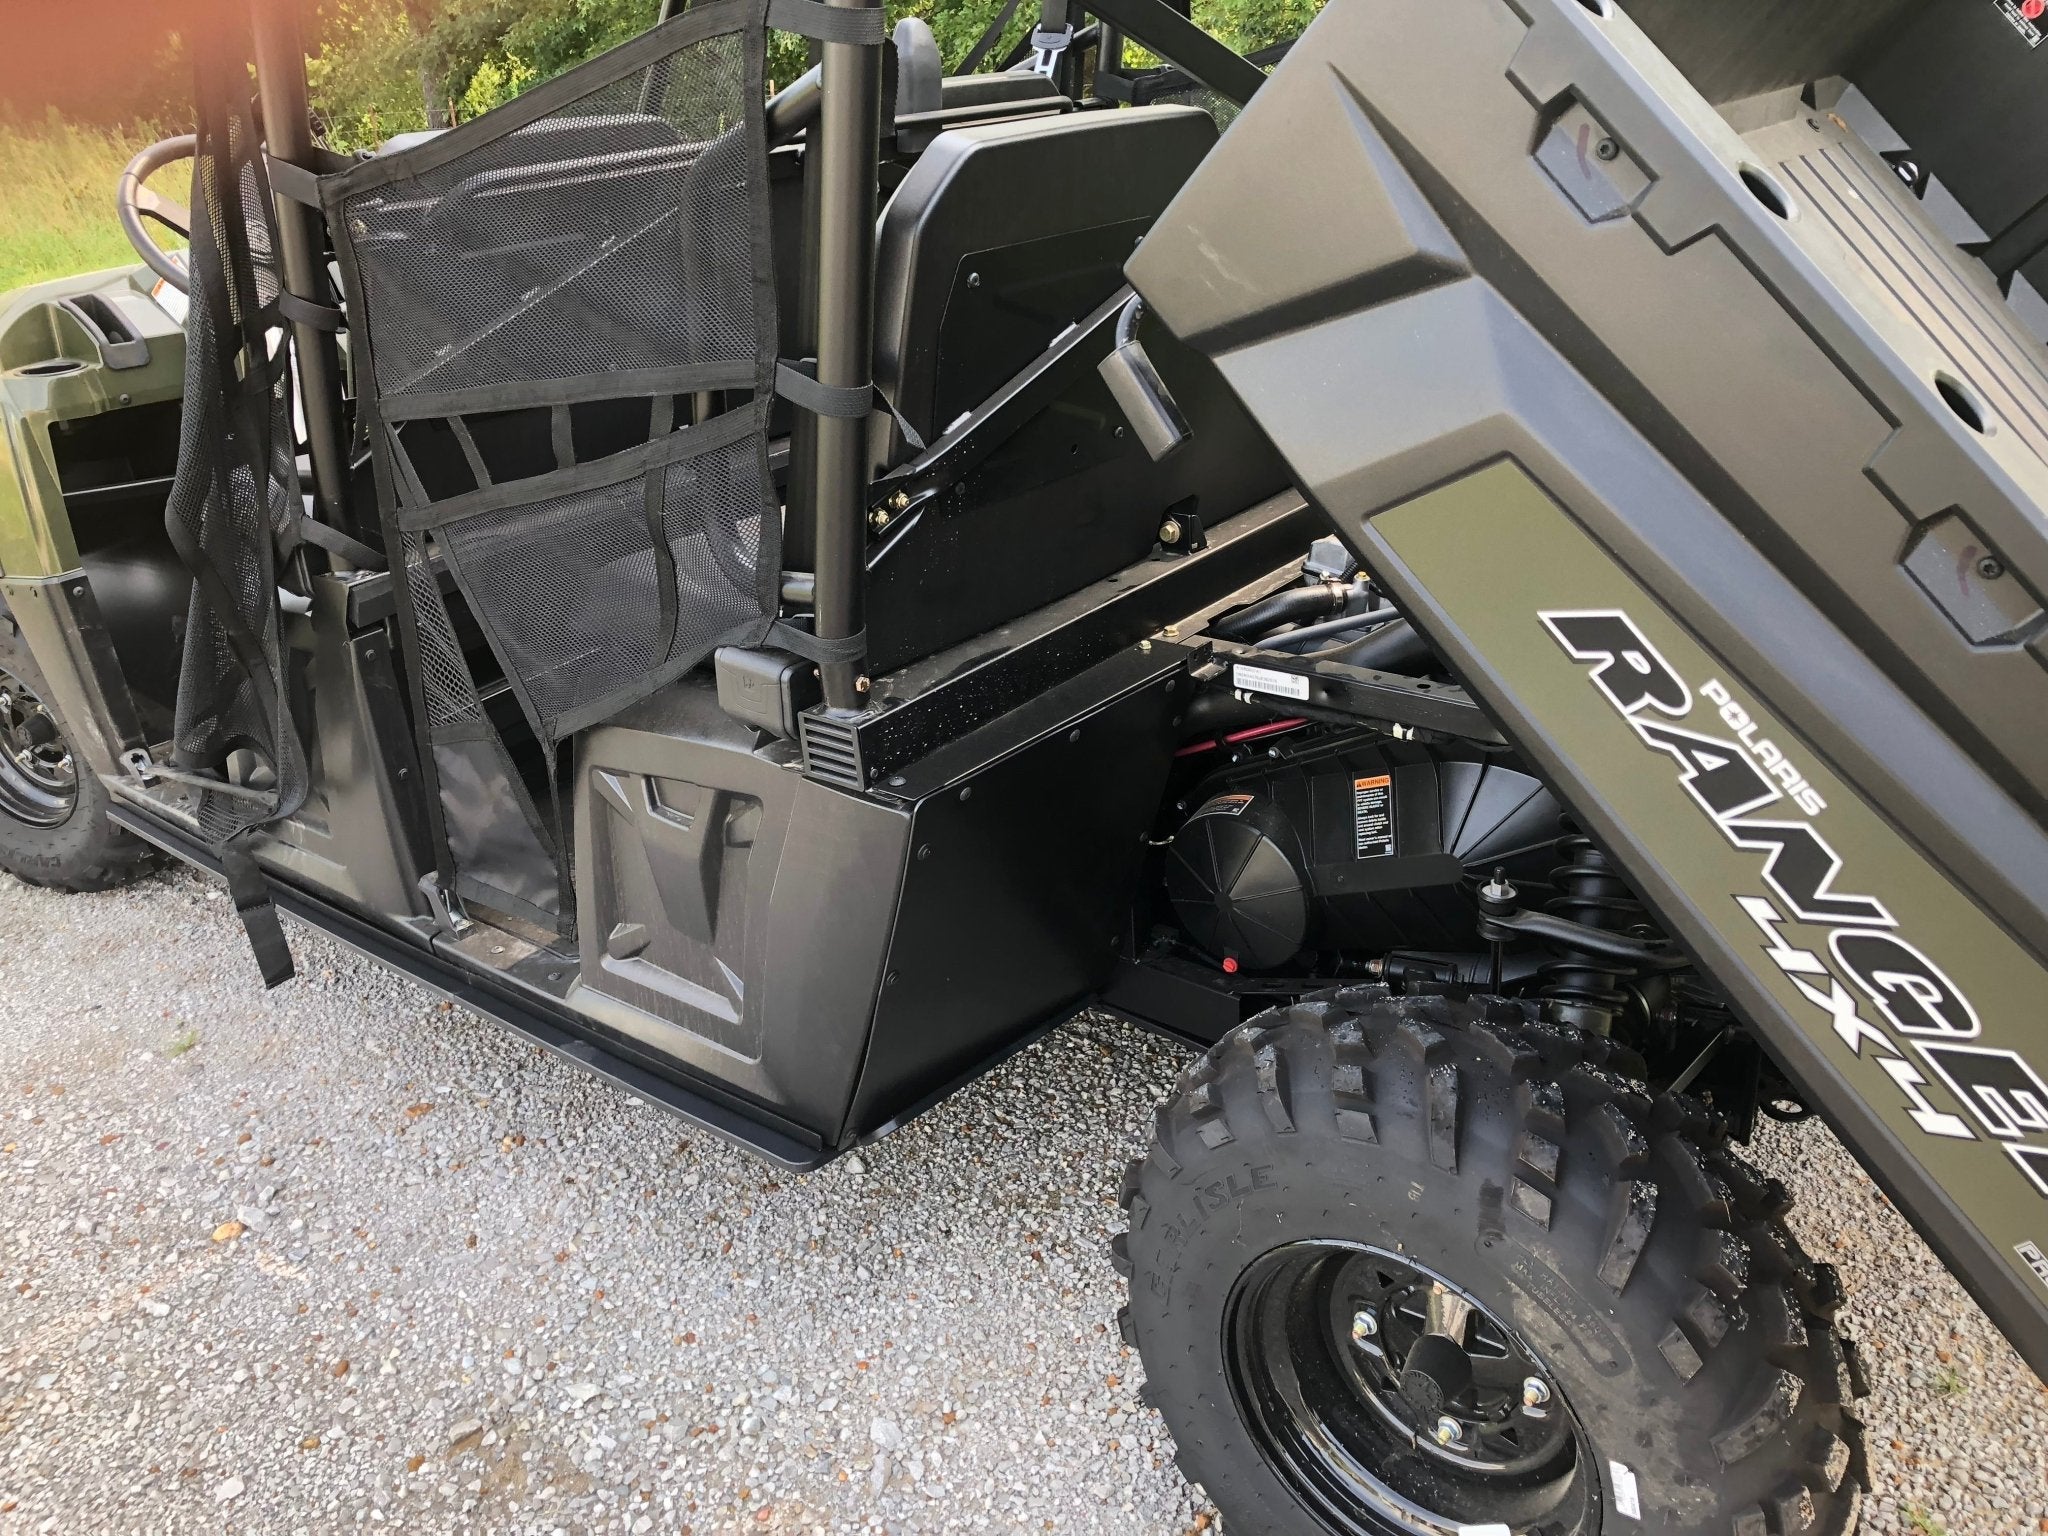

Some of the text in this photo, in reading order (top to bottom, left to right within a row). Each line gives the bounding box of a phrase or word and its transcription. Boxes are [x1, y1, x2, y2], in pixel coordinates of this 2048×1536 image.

[1361, 777, 1389, 788] WARNING
[1700, 678, 1828, 816] POLARIS
[1731, 894, 1983, 1141] 4X4
